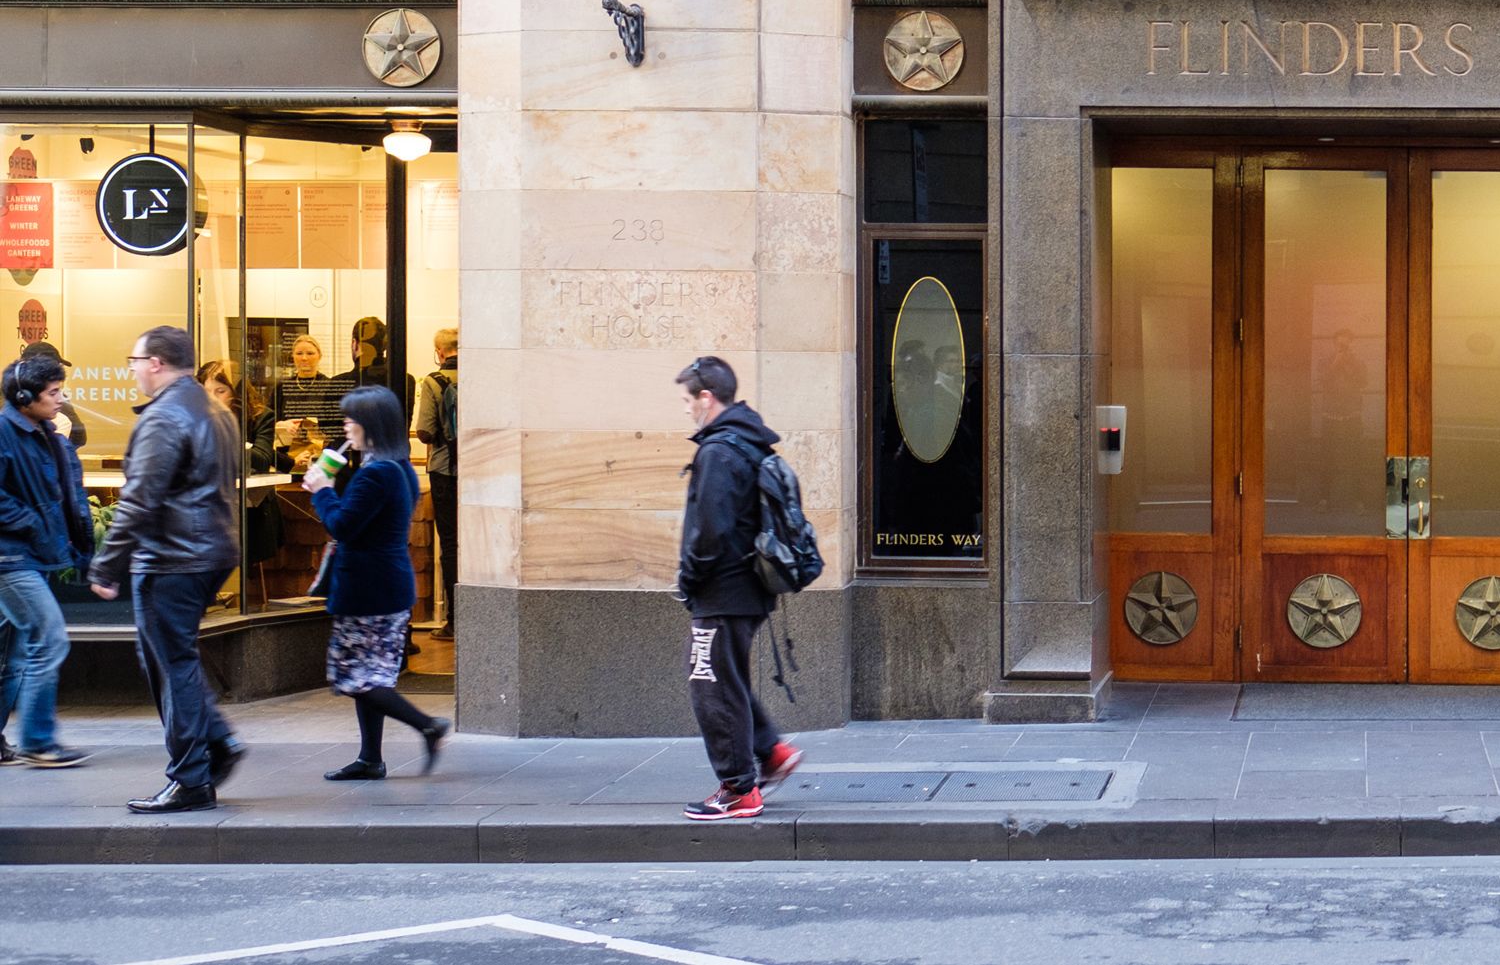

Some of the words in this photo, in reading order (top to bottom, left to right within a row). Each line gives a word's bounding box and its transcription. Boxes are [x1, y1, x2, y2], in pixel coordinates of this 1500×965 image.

[1146, 20, 1475, 77] FLINDERS
[9, 156, 37, 171] GREEN
[6, 195, 41, 204] LANEWAY
[9, 204, 39, 212] GREENS
[9, 222, 39, 230] WINTER
[612, 219, 665, 242] 238
[0, 239, 50, 247] WHOLEFOODS
[8, 249, 41, 257] CANTEEN
[559, 281, 719, 308] FLINDERS
[18, 310, 47, 323] GREEN
[16, 326, 48, 340] TASTES
[591, 314, 685, 340] HOUSE
[72, 367, 139, 381] ANEW
[876, 533, 944, 546] FLINDERS
[951, 534, 981, 546] WAY
[689, 627, 718, 683] EVERLAST
